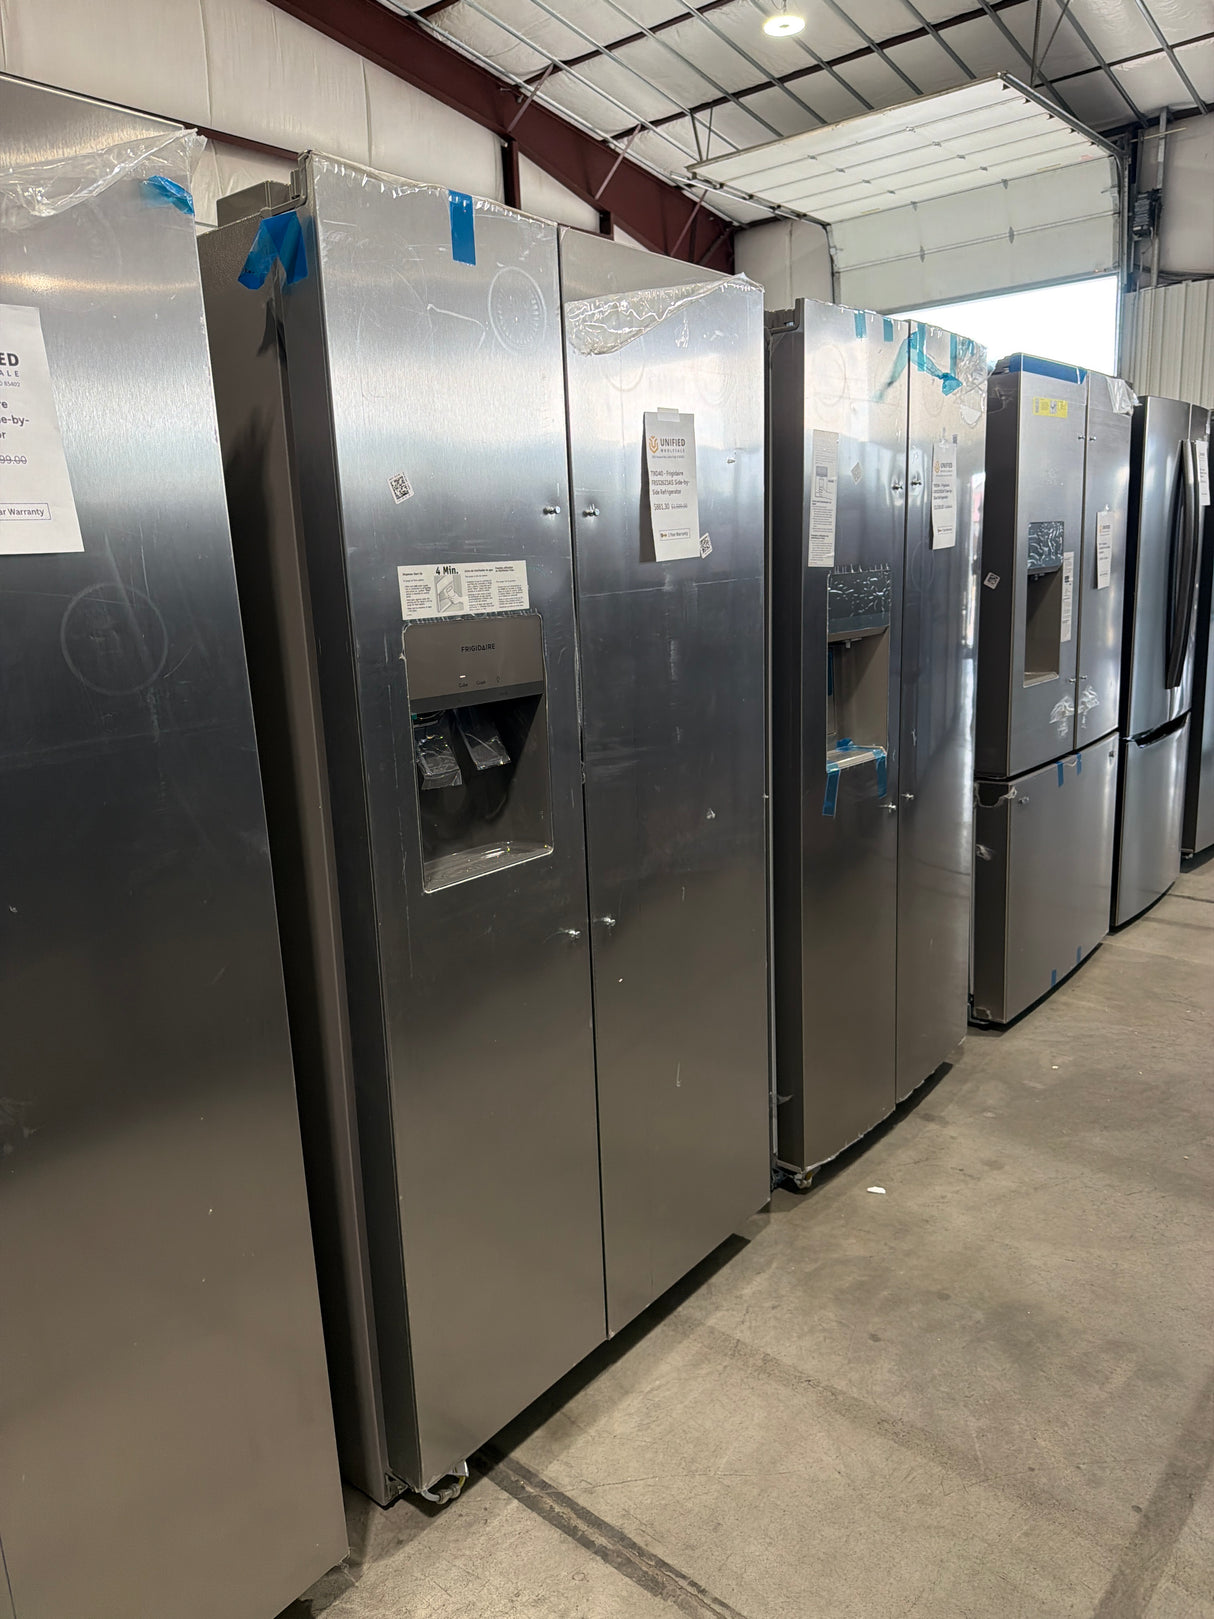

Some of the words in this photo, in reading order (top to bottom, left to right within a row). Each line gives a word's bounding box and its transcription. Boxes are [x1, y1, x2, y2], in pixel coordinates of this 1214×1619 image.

[659, 438, 686, 447] UNIFIED
[7, 508, 45, 518] Warranty
[435, 566, 441, 576] 4
[442, 565, 459, 575] Min.
[460, 643, 496, 653] FRIGIDAIRE
